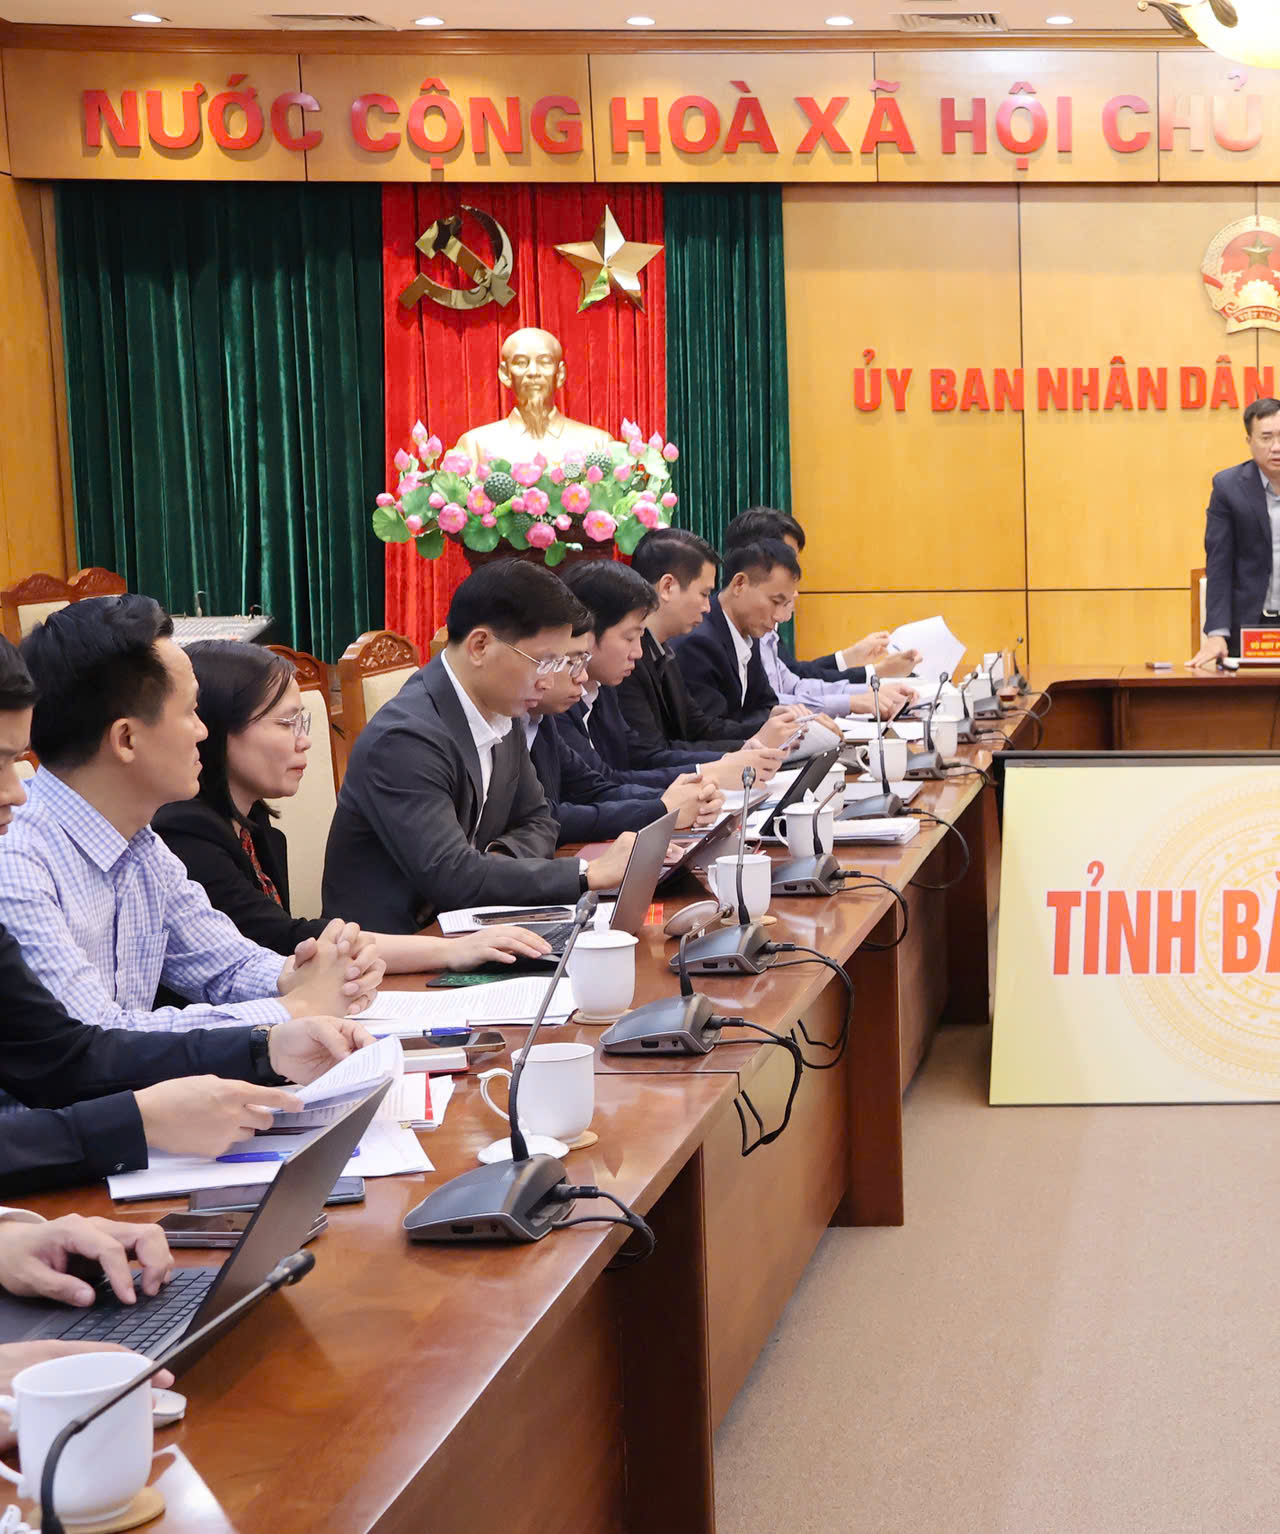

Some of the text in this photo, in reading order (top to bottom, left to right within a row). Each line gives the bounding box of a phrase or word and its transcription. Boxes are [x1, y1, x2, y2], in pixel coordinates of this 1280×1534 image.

[82, 73, 321, 151] NƯỚC
[349, 78, 582, 170] CỘNG
[611, 80, 778, 154] HOÀ
[796, 79, 916, 154] XÃ
[941, 81, 1073, 171] HỘI
[1102, 68, 1263, 153] CHỦ
[854, 347, 912, 411] ỦY
[931, 367, 1025, 411] BAN
[1037, 355, 1168, 411] NHÂN
[1180, 354, 1275, 410] DÂN
[1046, 860, 1197, 975] TỈNH
